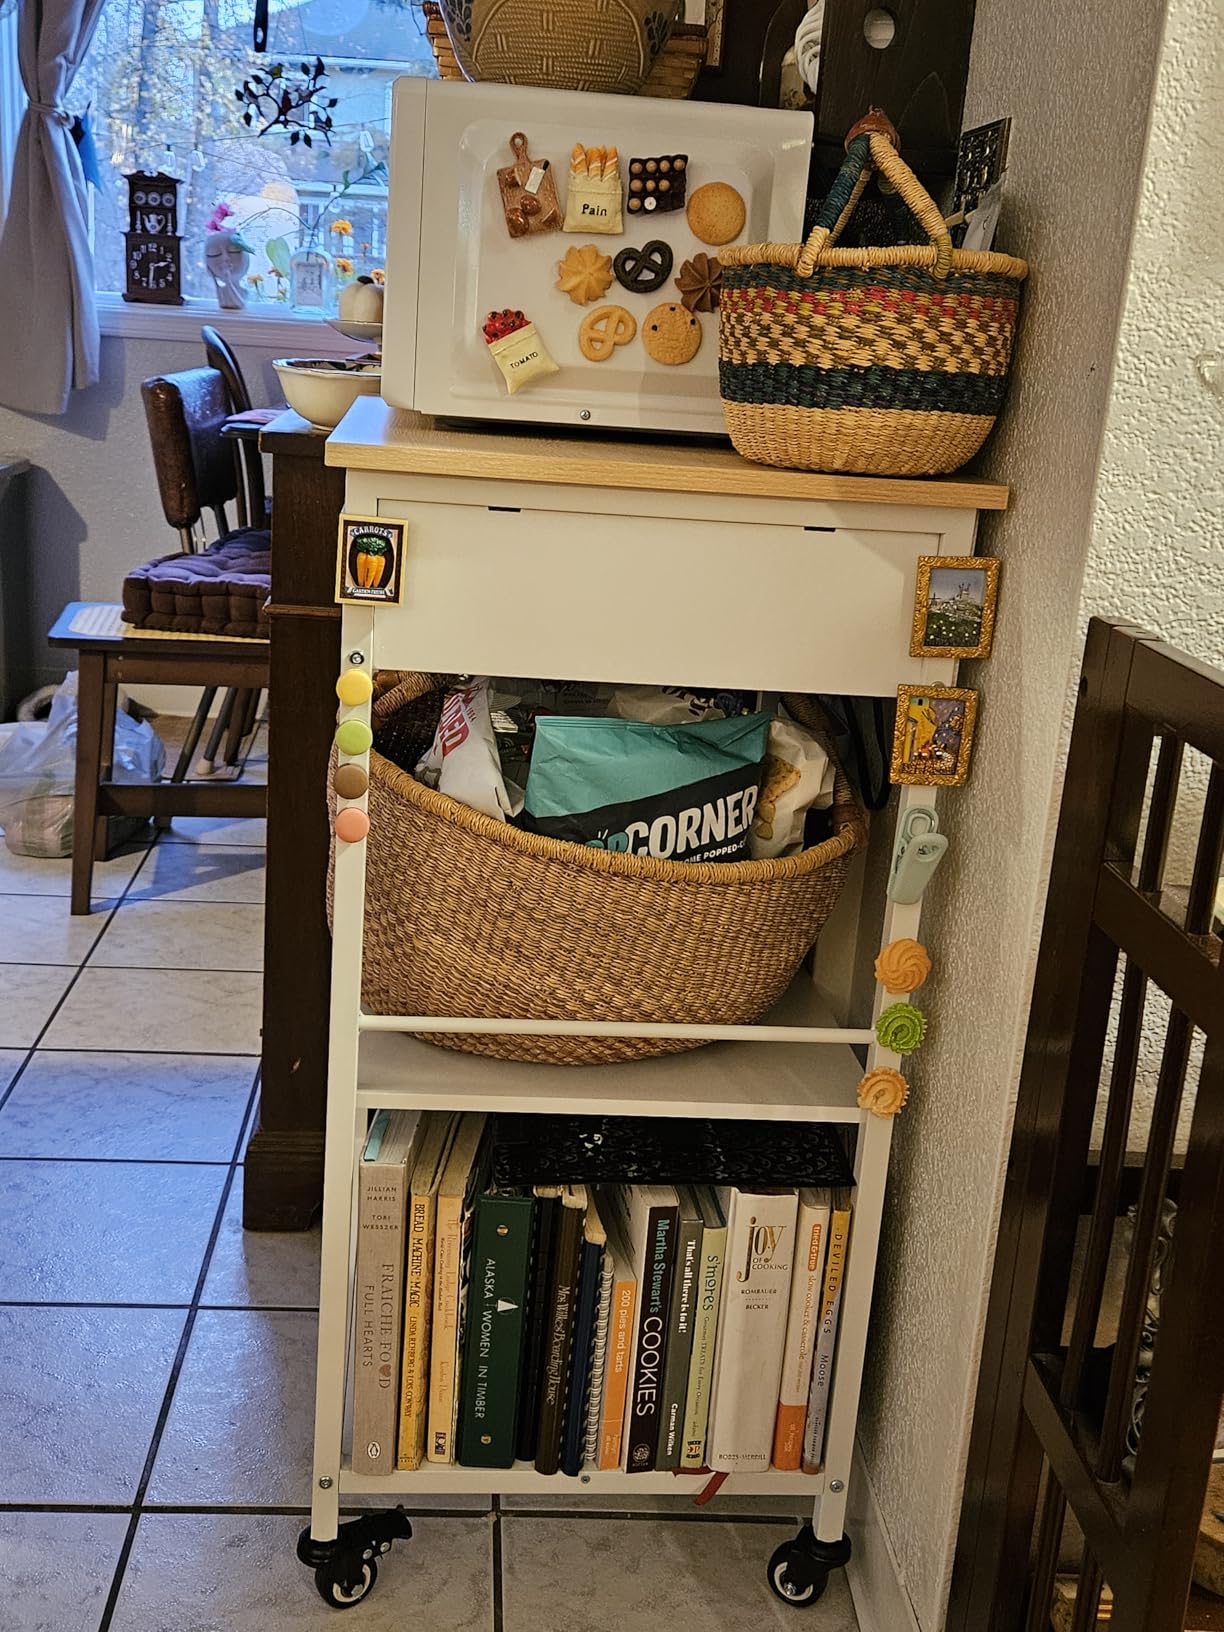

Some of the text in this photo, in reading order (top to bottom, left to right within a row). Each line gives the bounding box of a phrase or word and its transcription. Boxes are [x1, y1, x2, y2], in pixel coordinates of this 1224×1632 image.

[581, 203, 607, 216] Pain
[509, 351, 539, 369] TOMATO
[353, 525, 388, 536] CARROTS
[409, 1203, 425, 1308] BREAD MACHINE MAGIC
[736, 1216, 787, 1283] joy
[678, 1239, 696, 1334] That's all there is to it!
[803, 1293, 813, 1318] cooker
[823, 1233, 843, 1334] DEVILED EGGS
[362, 1285, 375, 1367] FULL HEARTS
[409, 1316, 418, 1337] LINDA
[474, 1258, 496, 1418] ALASKA WOMEN IN TIMBER
[615, 1290, 631, 1373] 200 pies and tarts
[636, 1219, 670, 1416] Martha Stewart's COOKIES
[547, 1332, 566, 1376] Boarding
[799, 1327, 809, 1359] casserole
[378, 1342, 392, 1389] FOD
[818, 1354, 829, 1387] Moose
[546, 1374, 561, 1406] House
[669, 1403, 678, 1431] Carman
